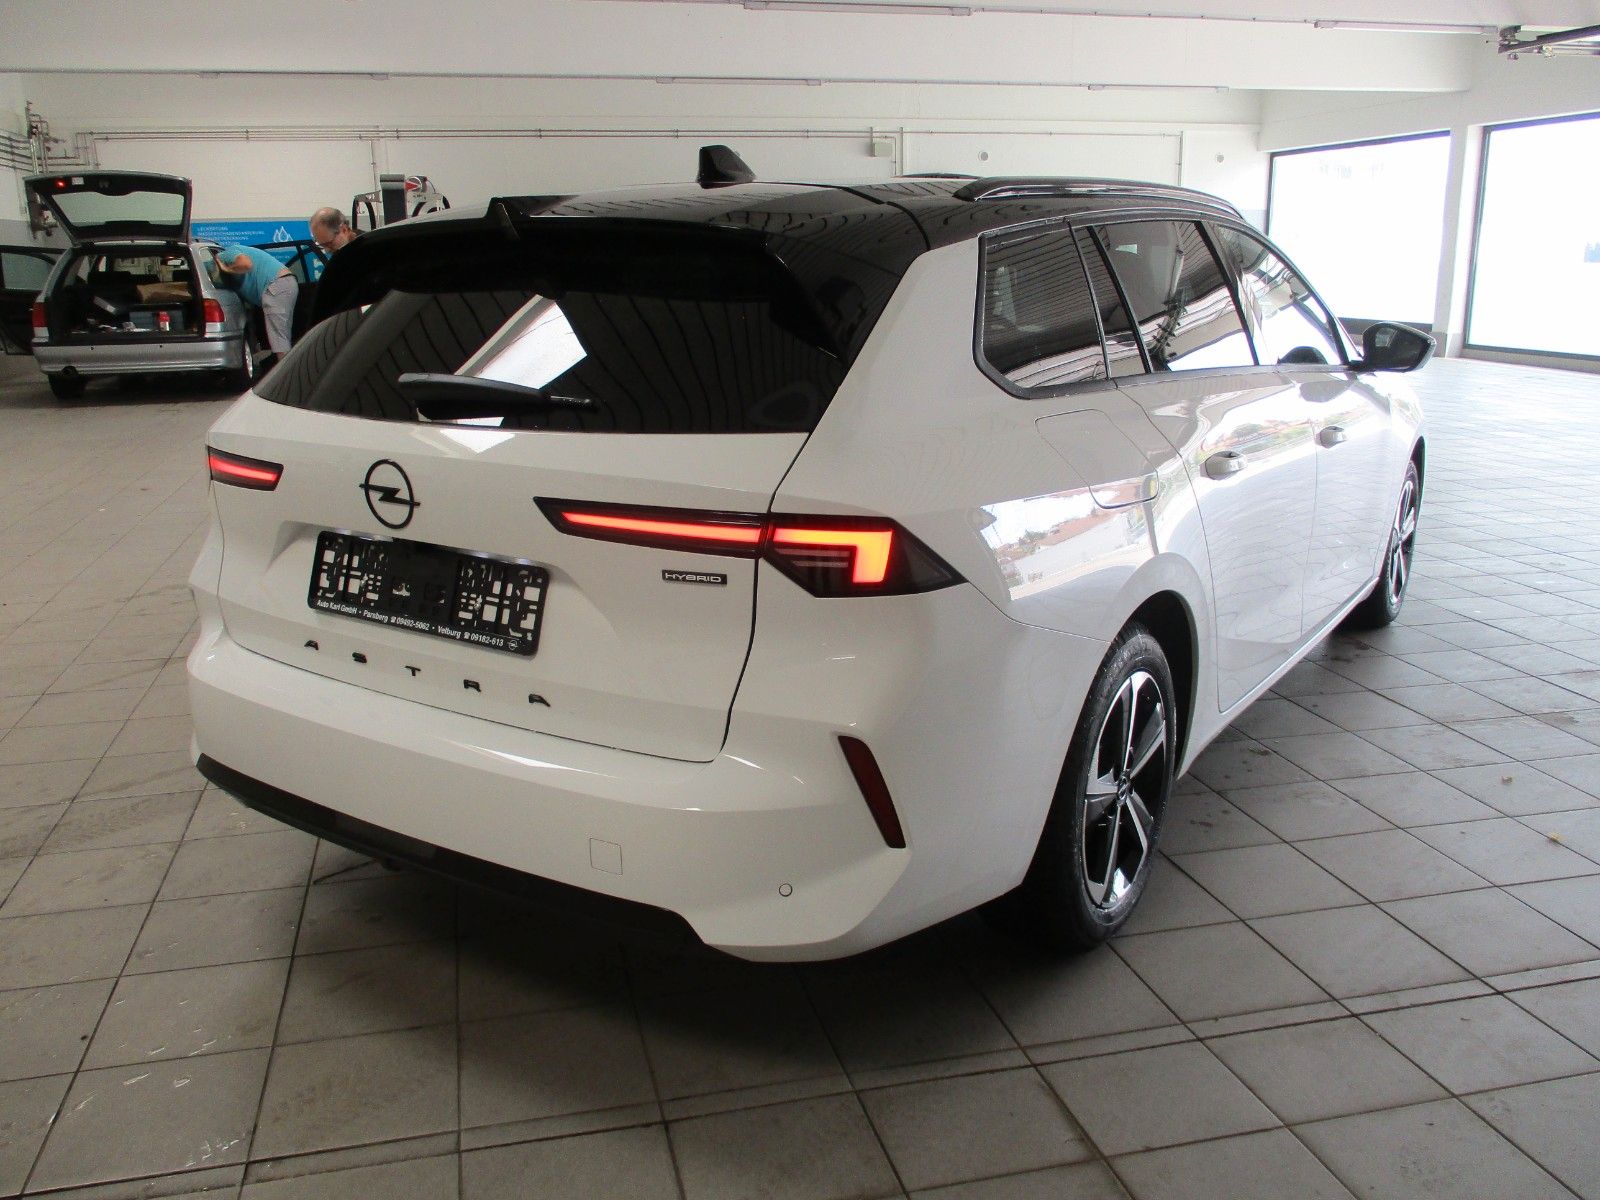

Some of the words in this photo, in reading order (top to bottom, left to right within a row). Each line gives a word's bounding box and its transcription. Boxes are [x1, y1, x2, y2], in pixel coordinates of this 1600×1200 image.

[664, 572, 722, 583] HYBRID
[316, 599, 330, 608] Auto
[330, 602, 341, 611] Karl
[341, 604, 358, 615] GmbH
[363, 609, 389, 623] Parsberg
[438, 625, 462, 639] Velburg
[471, 632, 504, 647] 09182-613
[304, 639, 551, 708] ASTRA
